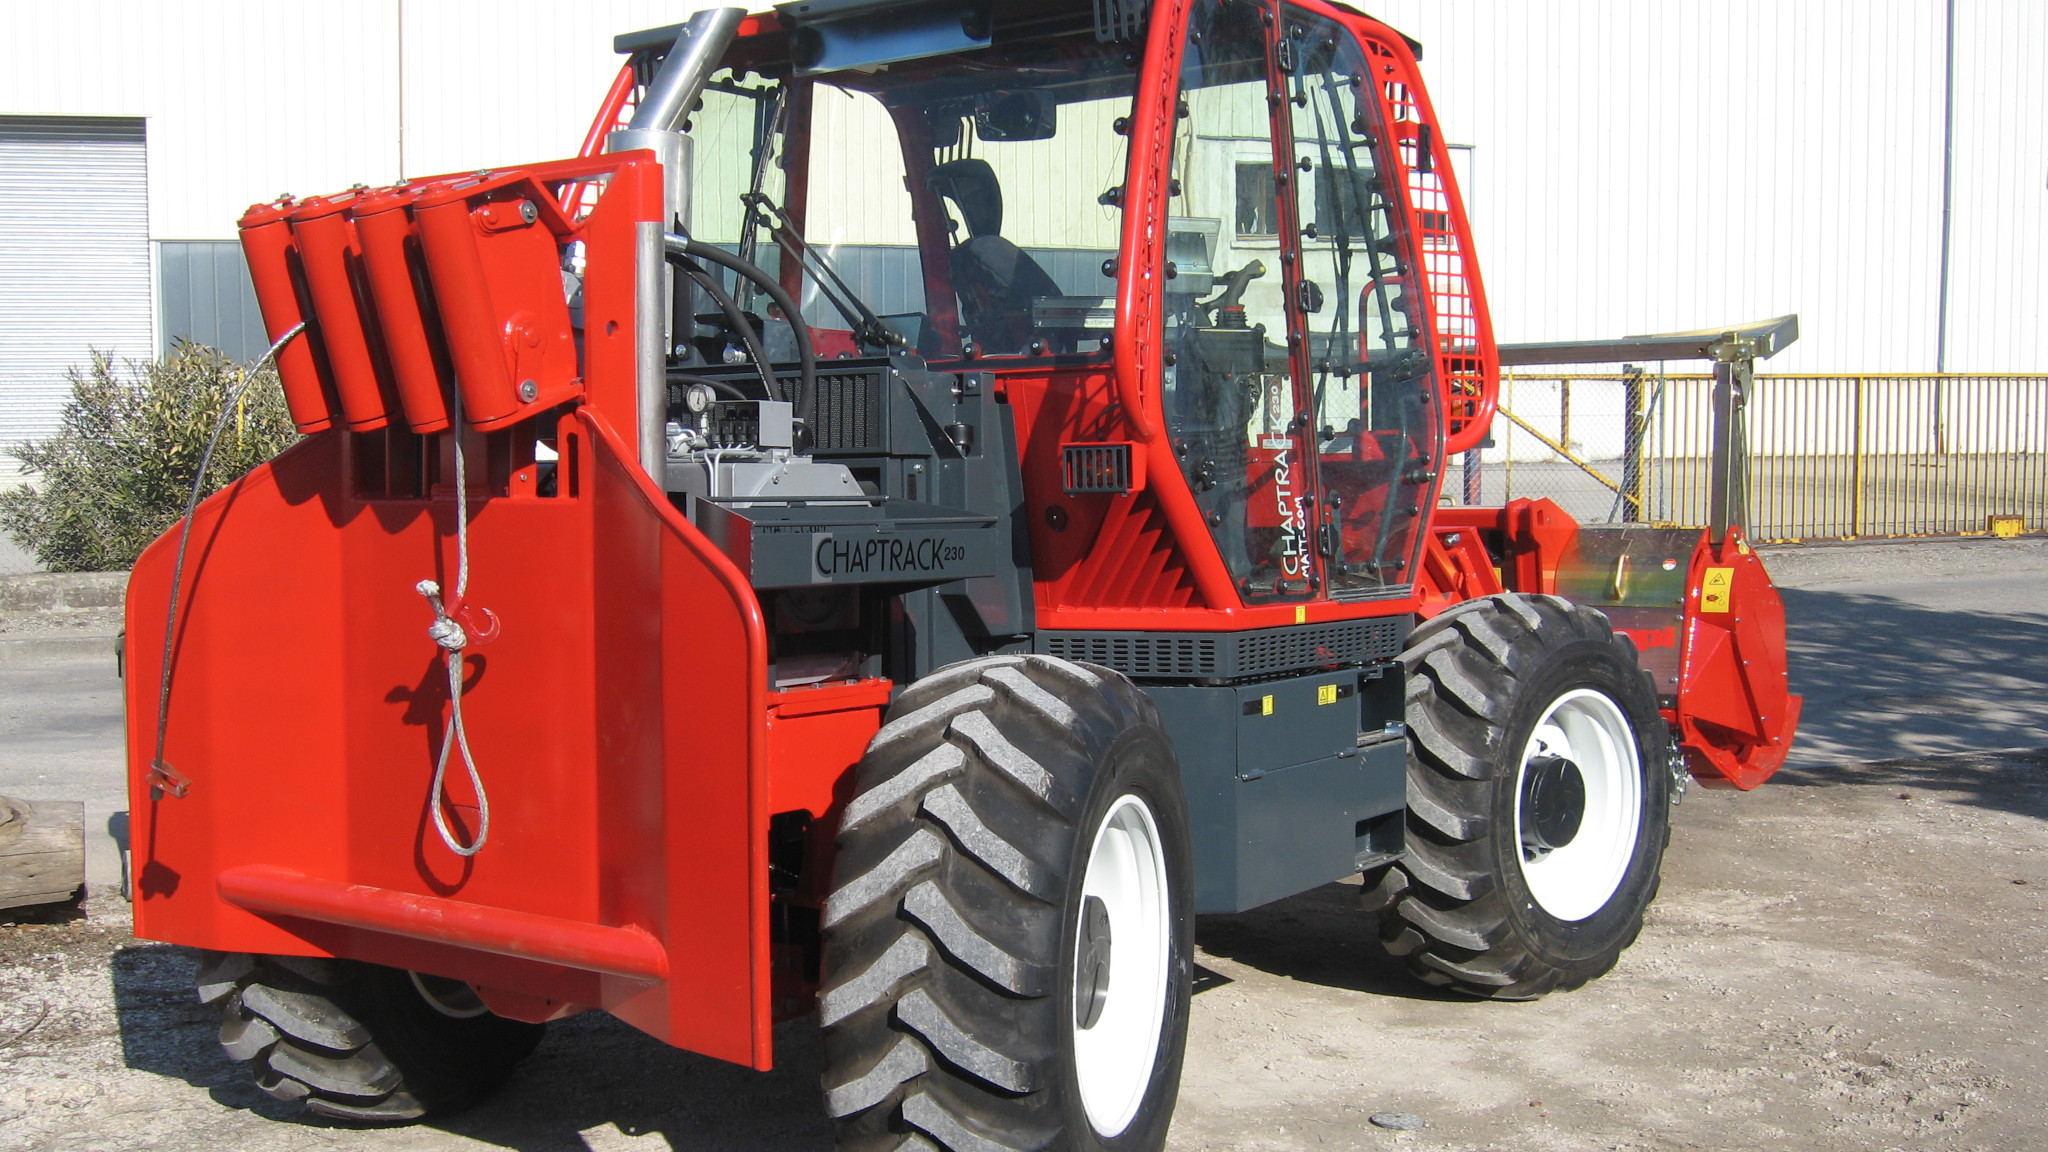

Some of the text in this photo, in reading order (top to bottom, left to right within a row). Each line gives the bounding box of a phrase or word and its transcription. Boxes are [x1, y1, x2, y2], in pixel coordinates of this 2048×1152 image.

[1271, 385, 1280, 414] 230
[1270, 412, 1298, 575] CHAPTRACK
[816, 537, 965, 575] CHAPTRACK 230
